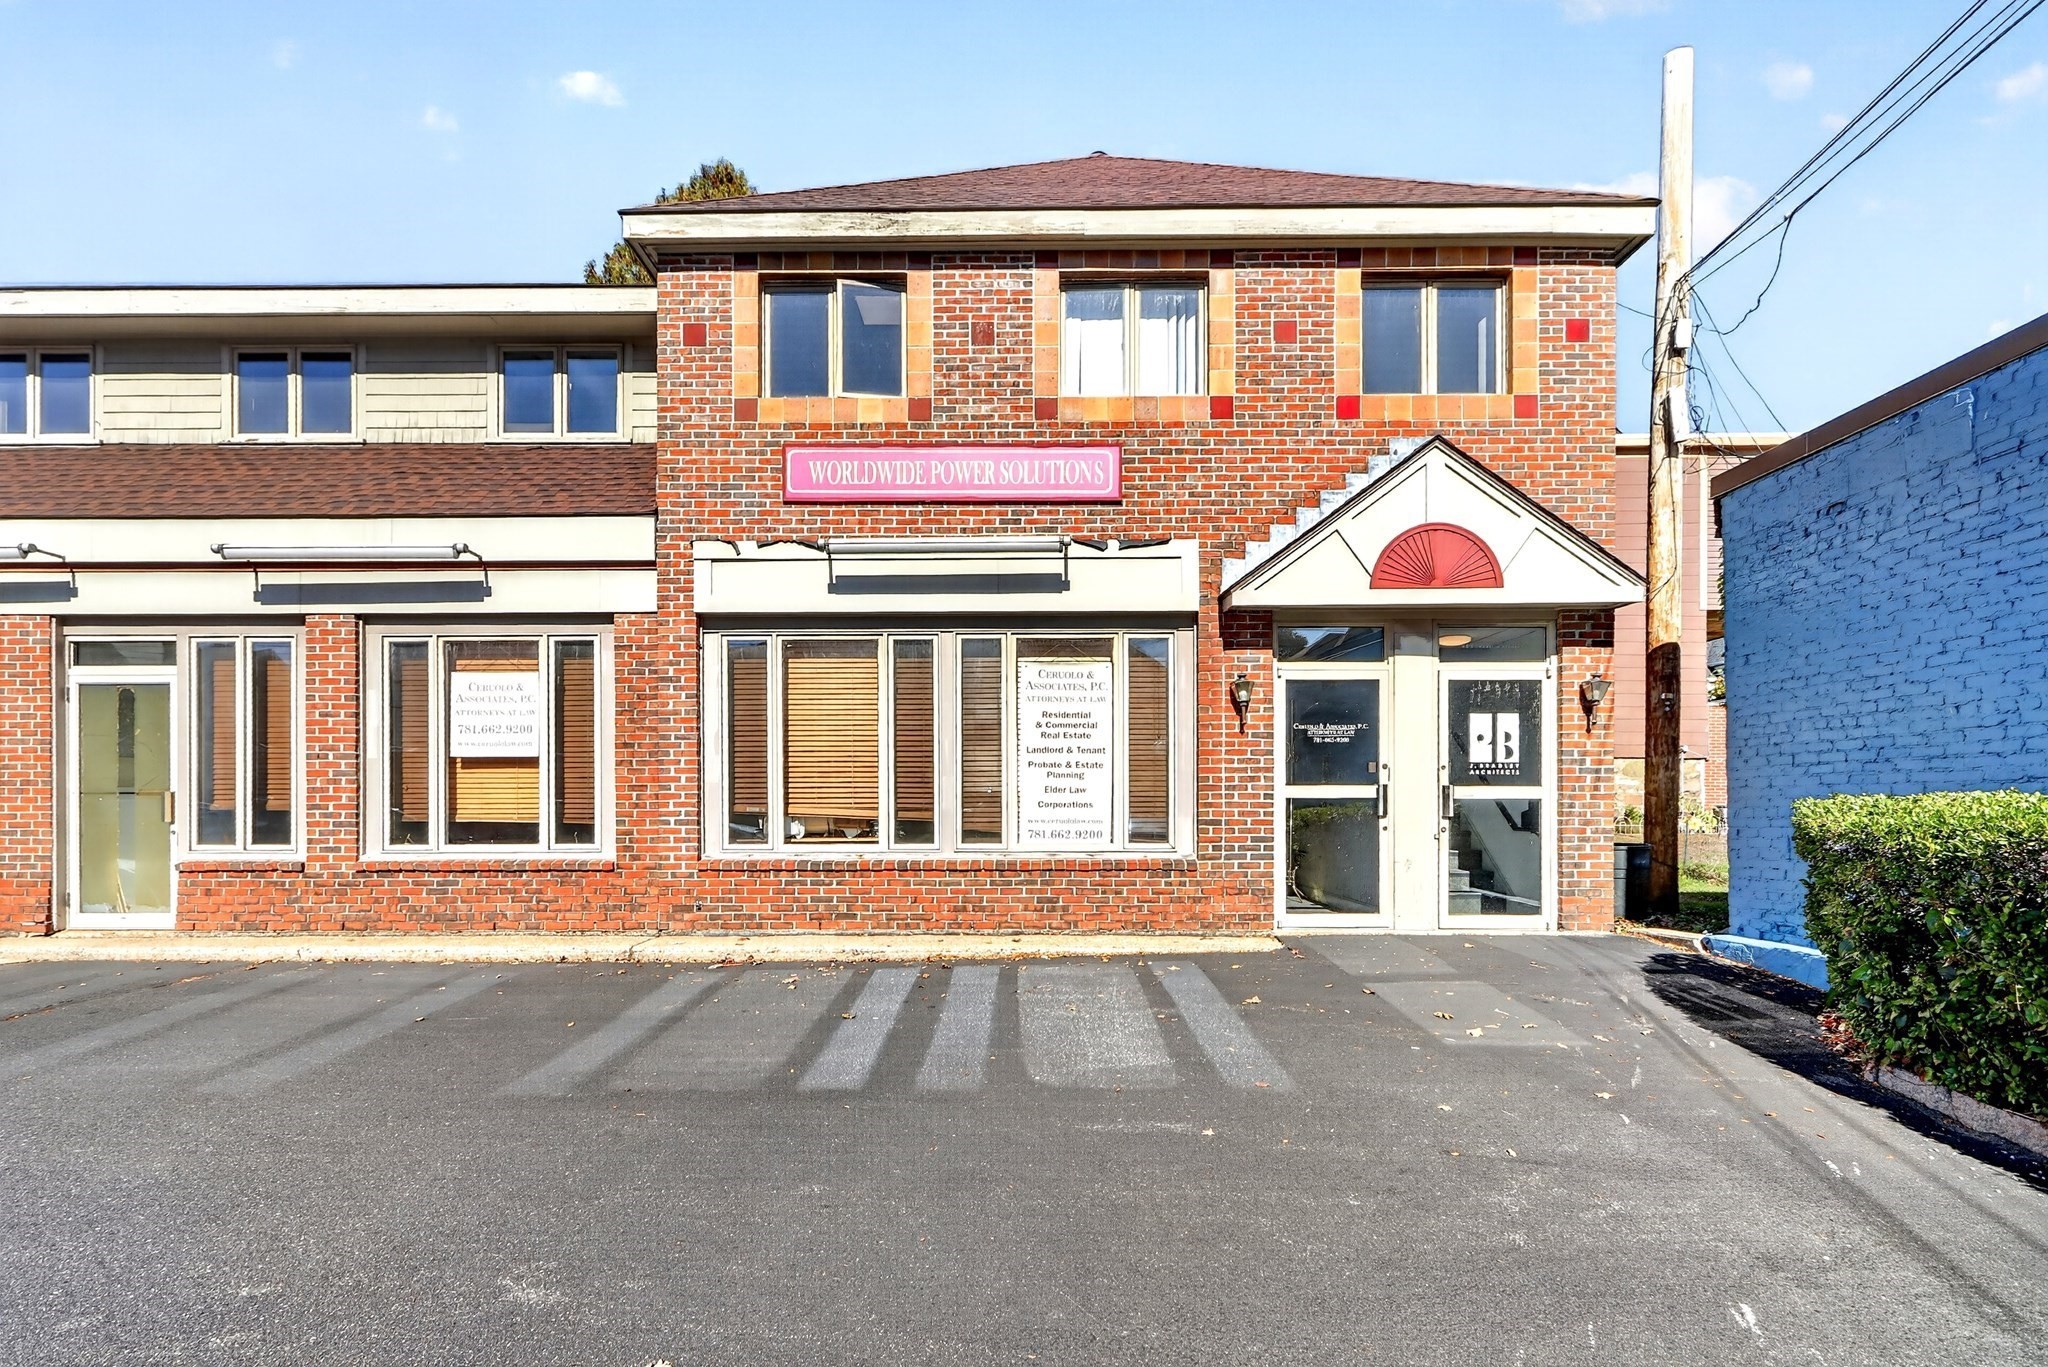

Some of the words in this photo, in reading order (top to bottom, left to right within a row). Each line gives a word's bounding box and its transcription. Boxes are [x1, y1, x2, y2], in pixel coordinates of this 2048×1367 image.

[808, 459, 927, 485] WORLDWIDE
[930, 459, 995, 485] POWER
[999, 459, 1104, 485] SOLUTIONS
[1038, 669, 1084, 679] CERUOLO
[1087, 669, 1095, 679] &
[516, 683, 524, 692] &
[1025, 681, 1087, 691] ASSOCIATES,
[1090, 682, 1108, 691] P.C.
[1042, 711, 1091, 719] Residential
[457, 724, 533, 735] 781.662.9200
[1036, 721, 1043, 729] &
[1045, 721, 1098, 729] Commercial
[1026, 746, 1063, 754] Landlord
[1066, 746, 1074, 754] &
[1077, 746, 1106, 754] Tenant
[1028, 761, 1062, 769] Probate
[1065, 761, 1073, 769] &
[1076, 761, 1104, 769] Estate
[1047, 771, 1085, 780] Planning
[1045, 786, 1066, 794] Elder
[1069, 786, 1087, 794] Law
[1038, 801, 1094, 809] Corporations
[1028, 829, 1103, 840] 781.662.9200
